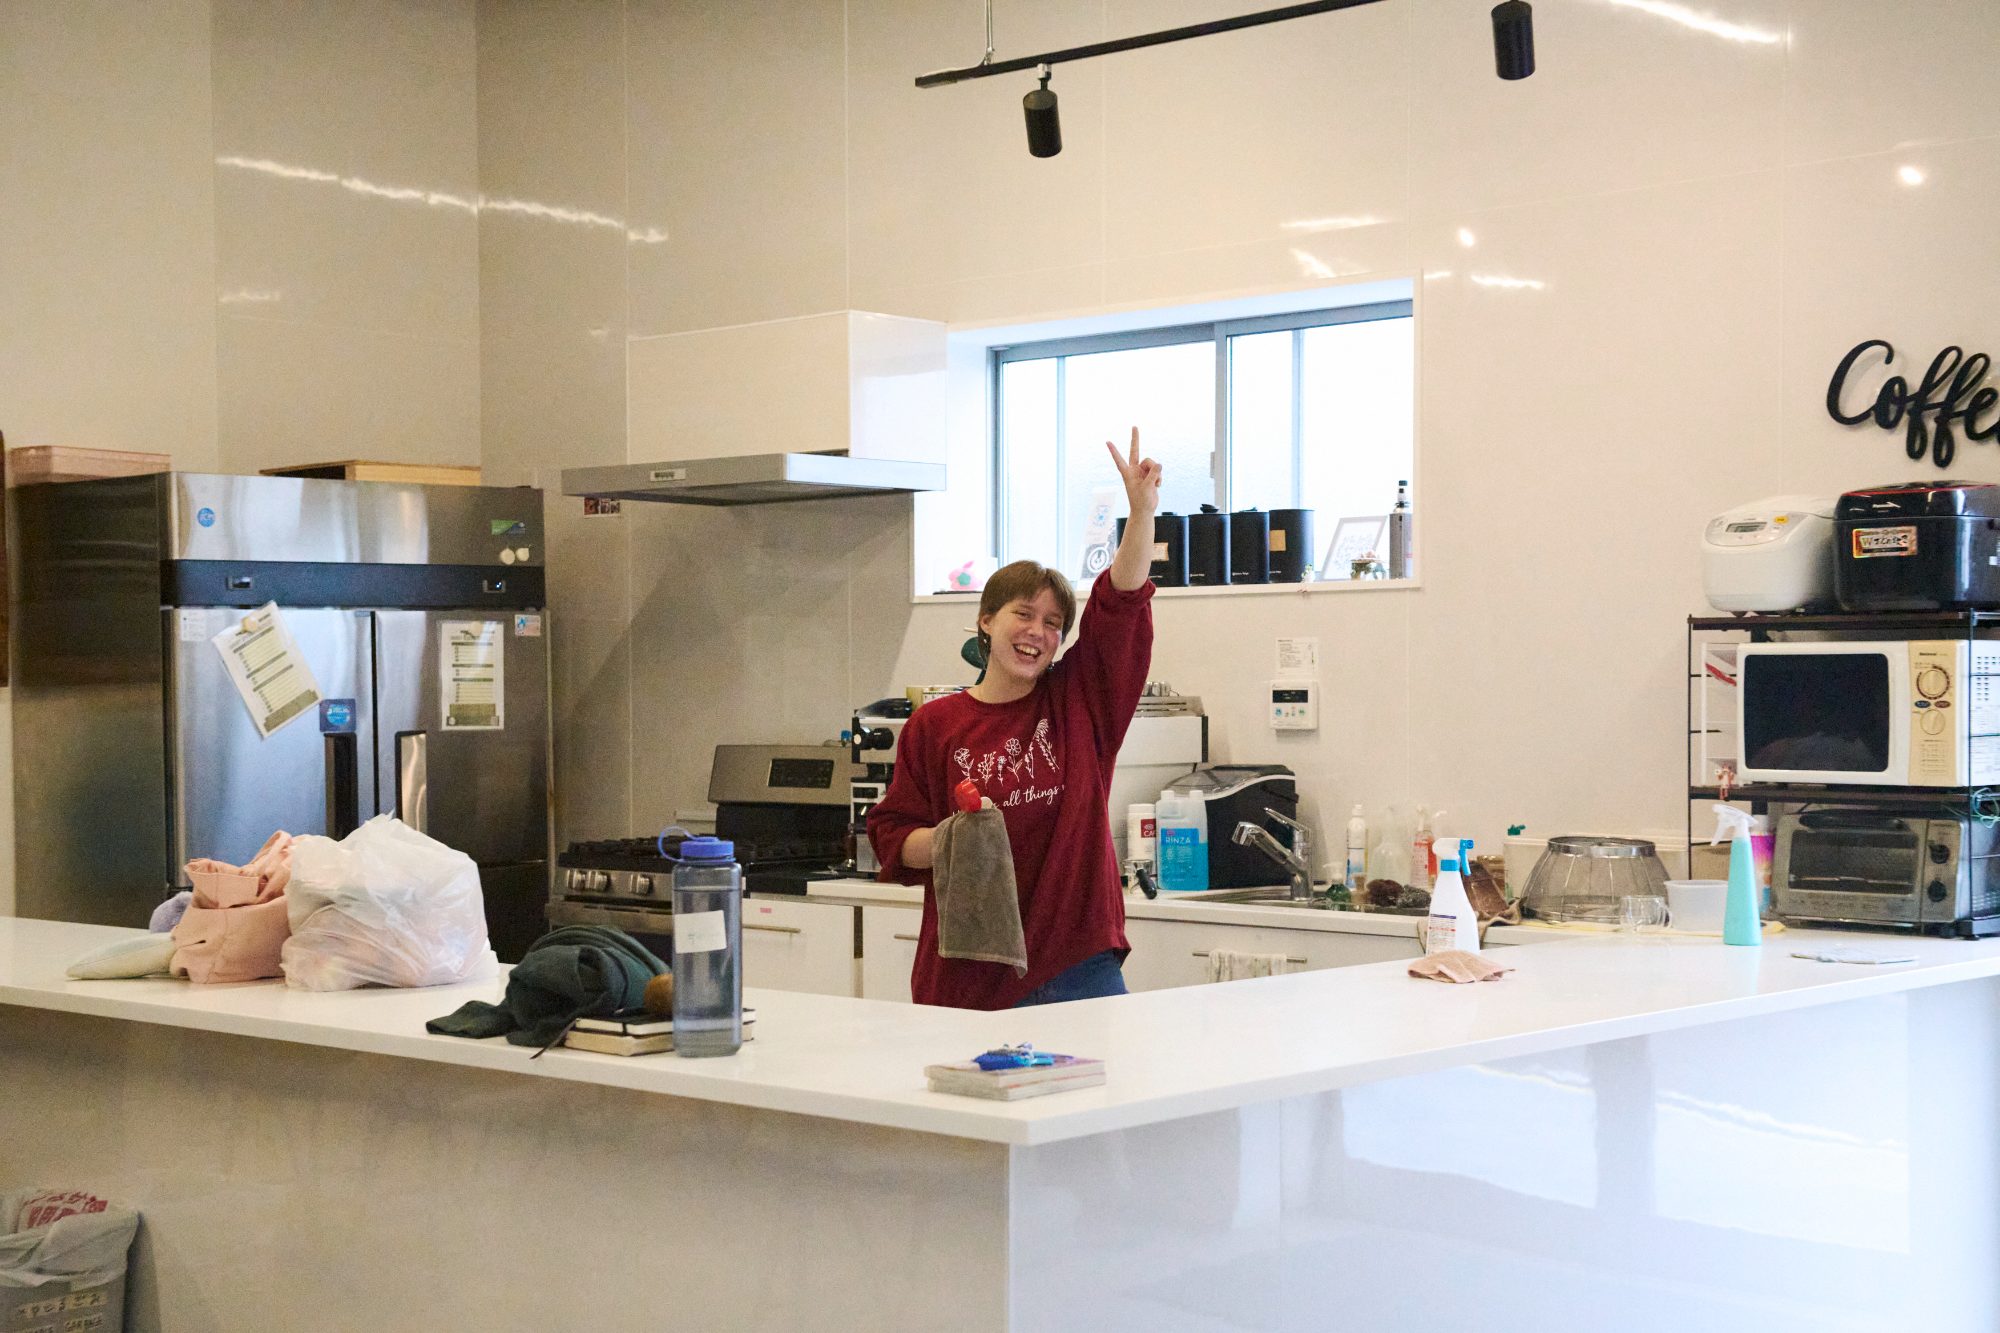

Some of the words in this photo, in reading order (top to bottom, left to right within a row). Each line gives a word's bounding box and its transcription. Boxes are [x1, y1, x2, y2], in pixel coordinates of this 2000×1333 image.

[1827, 339, 2000, 468] Coffe
[1003, 789, 1021, 807] all
[1023, 785, 1060, 806] things
[1165, 836, 1191, 844] RINZA
